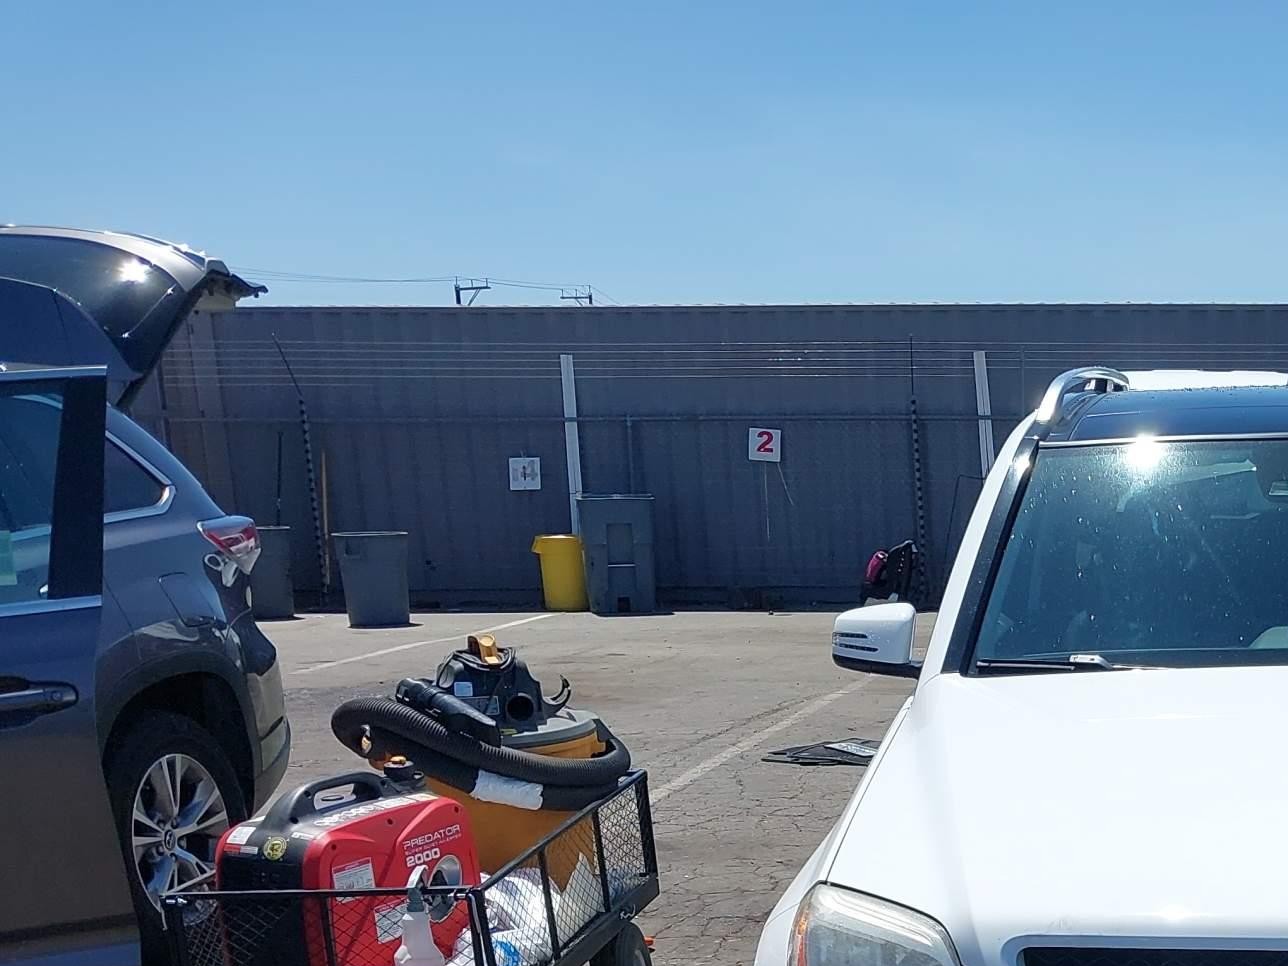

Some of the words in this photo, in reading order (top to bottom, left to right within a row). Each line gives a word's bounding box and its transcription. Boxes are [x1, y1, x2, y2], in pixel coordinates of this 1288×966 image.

[755, 430, 774, 453] 2
[402, 824, 460, 850] PREDATOR
[406, 848, 441, 868] 2000
